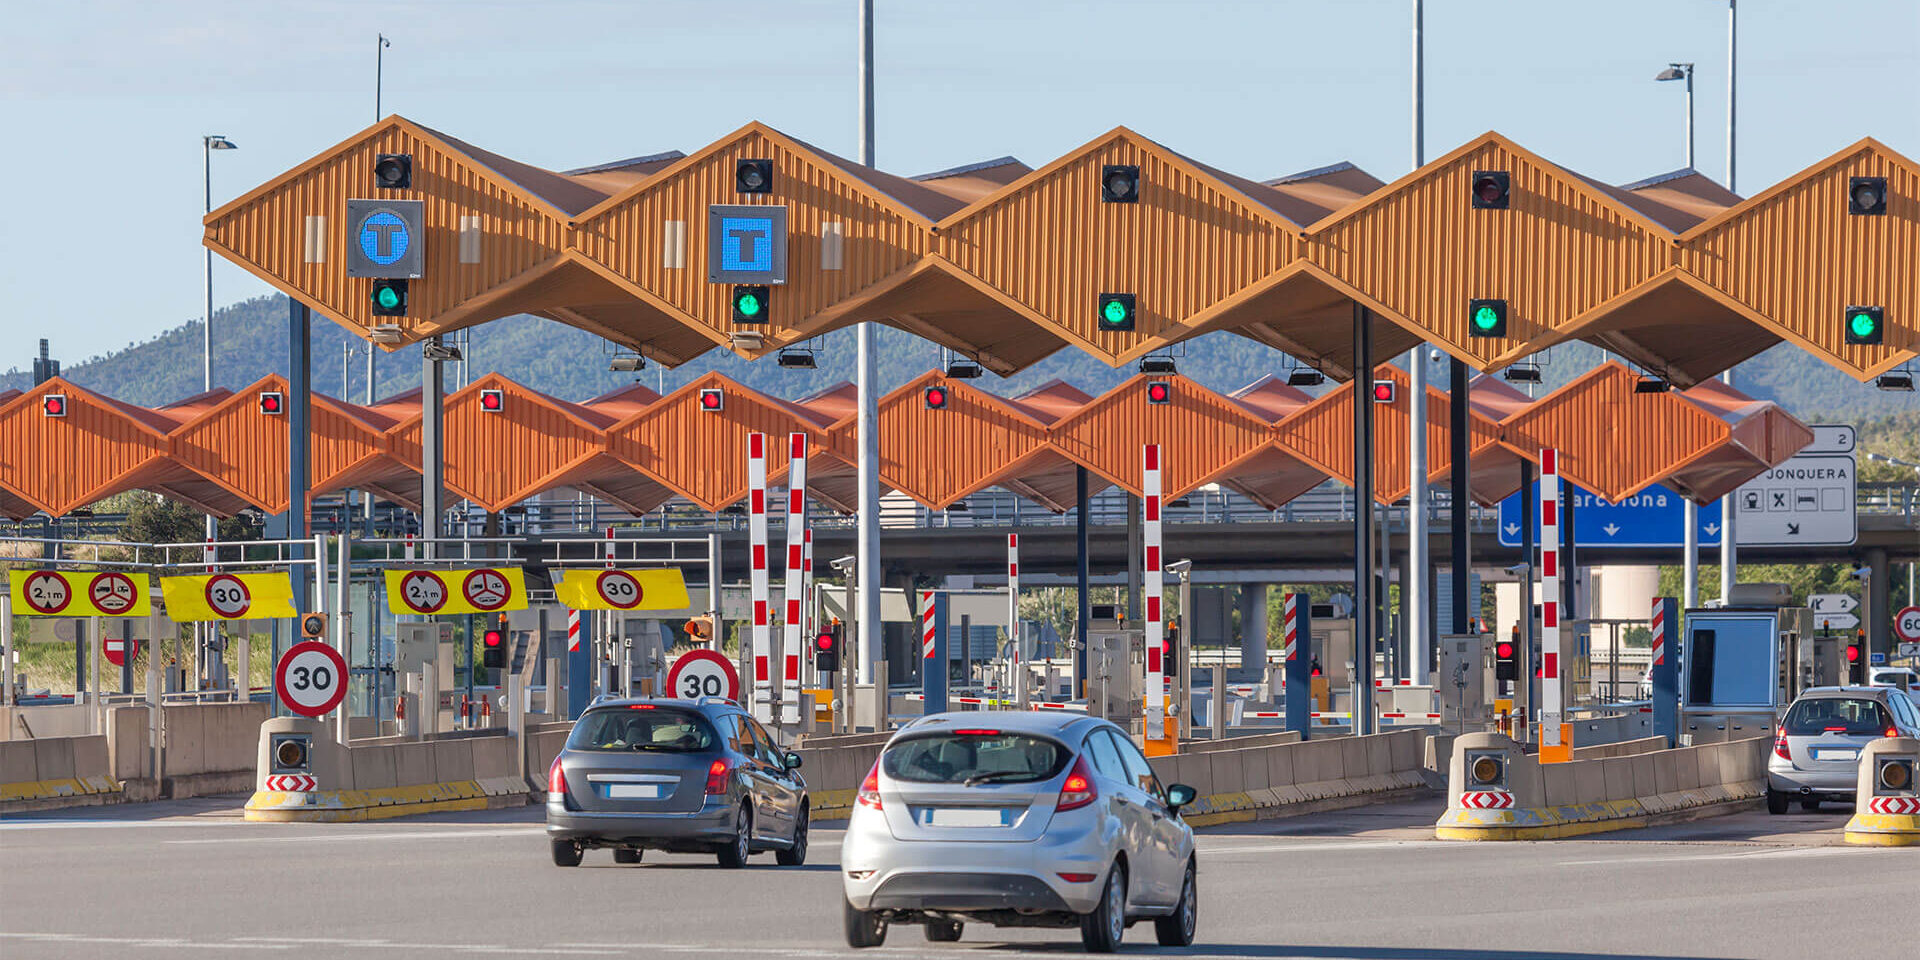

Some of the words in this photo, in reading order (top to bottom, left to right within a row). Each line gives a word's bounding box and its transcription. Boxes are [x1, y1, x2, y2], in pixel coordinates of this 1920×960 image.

[366, 224, 402, 256] T
[729, 229, 765, 262] T
[1838, 434, 1847, 445] 2
[1766, 468, 1847, 480] JONQUERA
[1558, 491, 1668, 507] Barclona
[215, 588, 241, 603] 30
[606, 582, 633, 596] 30
[1840, 599, 1848, 609] 2
[293, 666, 331, 691] 30
[683, 674, 722, 699] 30
